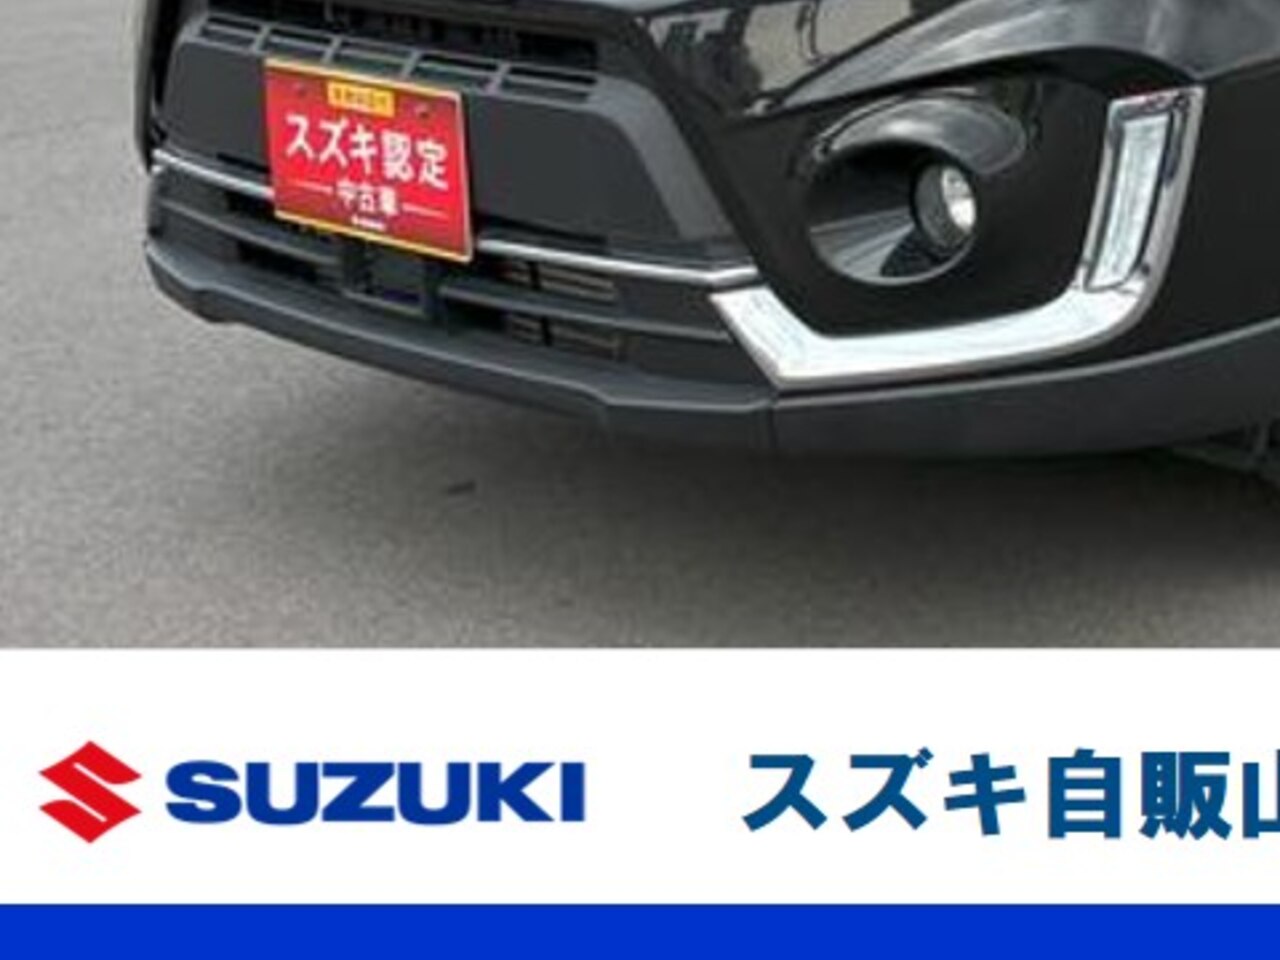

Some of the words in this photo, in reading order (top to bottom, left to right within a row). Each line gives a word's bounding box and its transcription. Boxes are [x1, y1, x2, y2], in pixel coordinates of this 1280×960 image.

[285, 113, 449, 190] スズキ認定
